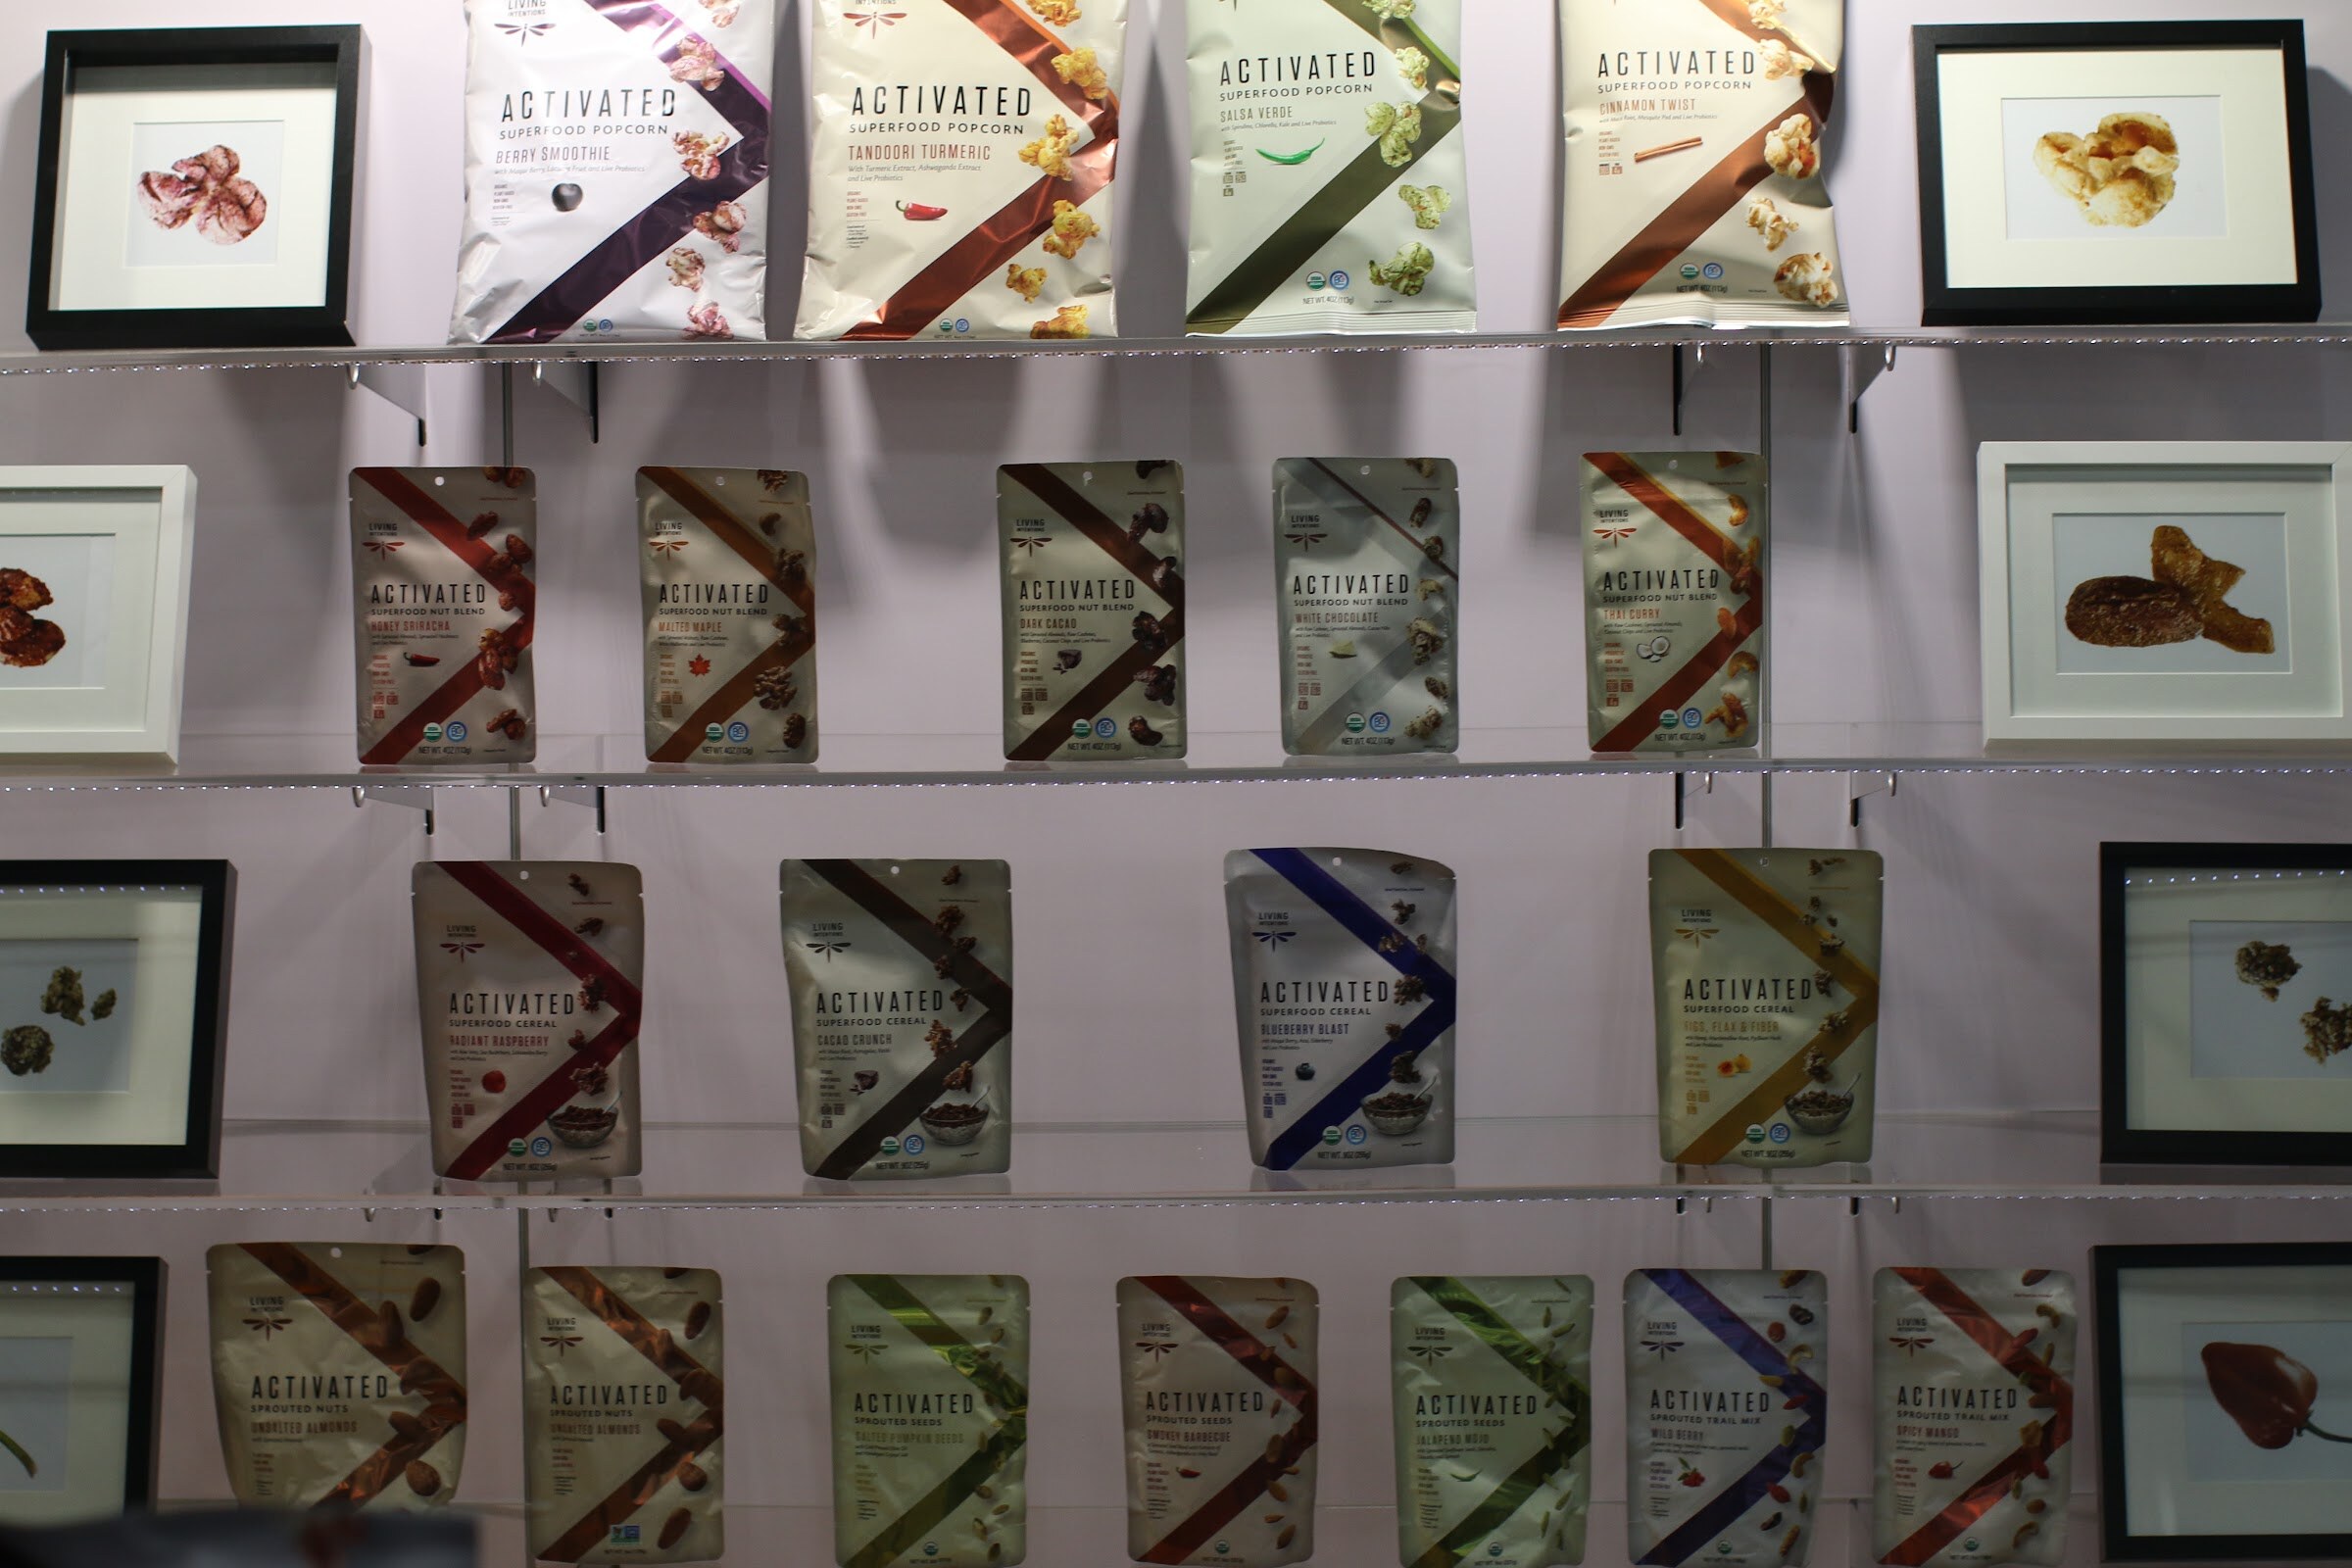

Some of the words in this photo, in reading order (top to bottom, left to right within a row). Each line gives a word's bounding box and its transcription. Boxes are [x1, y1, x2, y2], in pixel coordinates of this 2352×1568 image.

[1220, 51, 1375, 86] ACTIVATED
[1598, 51, 1755, 78] ACTIVATED
[1220, 87, 1299, 102] SUPERFOOD
[1306, 84, 1372, 95] POPCORN
[1597, 81, 1678, 94] SUPERFOOD
[1685, 80, 1751, 89] POPCORN
[502, 89, 675, 122] ACTIVATED
[852, 85, 1030, 116] ACTIVATED
[1599, 99, 1655, 116] CINNAMON
[1660, 98, 1695, 111] TWIST
[1220, 108, 1253, 122] SALSA
[1258, 106, 1293, 119] VERDE
[500, 125, 586, 139] SUPERFOOD
[593, 124, 668, 134] POPCORN
[850, 122, 941, 133] SUPERFOOD
[949, 122, 1024, 134] POPCORN
[496, 148, 536, 164] BERRY
[541, 146, 610, 161] SMOOTHIE
[849, 145, 914, 160] TANDOORI
[922, 144, 991, 160] TURMERIC
[1291, 514, 1320, 523] LIVING
[1599, 509, 1629, 517] LIVING
[368, 522, 398, 531] LIVING
[655, 522, 683, 531] LIVING
[1016, 518, 1046, 527] LIVING
[1294, 574, 1409, 595] ACTIVATED
[1603, 569, 1719, 592] ACTIVATED
[371, 584, 486, 604] ACTIVATED
[659, 584, 768, 604] ACTIVATED
[1019, 579, 1135, 601] ACTIVATED
[1352, 598, 1374, 607] NUT
[1602, 594, 1662, 604] SUPERFOOD
[371, 608, 427, 616] SUPERFOOD
[1019, 604, 1076, 612] SUPERFOOD
[1102, 603, 1134, 612] BLEND
[1296, 612, 1322, 623] WHITE
[1325, 612, 1379, 623] CHOCOLATE
[1604, 609, 1627, 620] THAI
[1630, 609, 1661, 620] CURRY
[371, 620, 400, 632] HONEY
[403, 619, 450, 632] SRIRACHA
[659, 621, 690, 633] MALTED
[693, 621, 722, 633] MAPLE
[1020, 618, 1043, 629] DARK
[1046, 618, 1077, 629] CACAO
[1258, 911, 1289, 921] LIVING
[1682, 908, 1712, 917] LIVING
[812, 922, 843, 932] LIVING
[1260, 981, 1389, 1004] ACTIVATED
[1684, 978, 1811, 1001] ACTIVATED
[449, 993, 575, 1015] ACTIVATED
[815, 990, 944, 1014] ACTIVATED
[1260, 1007, 1325, 1016] SUPERFOOD
[1329, 1007, 1371, 1016] CEREAL
[1684, 1004, 1749, 1014] SUPERFOOD
[1753, 1004, 1794, 1014] CEREAL
[449, 1019, 512, 1028] SUPERFOOD
[515, 1019, 557, 1028] CEREAL
[815, 1017, 883, 1027] SUPERFOOD
[886, 1017, 927, 1026] CEREAL
[1749, 1021, 1780, 1033] FIBER
[1260, 1024, 1315, 1036] BLUEBERRY
[1318, 1023, 1349, 1035] BLAST
[449, 1035, 489, 1048] RADIANT
[492, 1036, 549, 1048] RASPBERRY
[817, 1034, 849, 1047] CACAO
[852, 1033, 893, 1046] CRUNCH
[249, 1296, 284, 1306] LIVING
[851, 1325, 881, 1334] LIVING
[1142, 1323, 1171, 1332] LIVING
[1414, 1327, 1446, 1336] LIVING
[1647, 1321, 1677, 1330] LIVING
[251, 1375, 388, 1399] ACTIVATED
[551, 1384, 668, 1406] ACTIVATED
[1649, 1389, 1770, 1413] ACTIVATED
[1897, 1385, 2017, 1409] ACTIVATED
[855, 1393, 974, 1414] ACTIVATED
[1146, 1391, 1263, 1413] ACTIVATED
[1416, 1395, 1537, 1415] ACTIVATED
[250, 1404, 312, 1413] SPROUTED
[316, 1404, 349, 1413] NUTS
[549, 1409, 602, 1418] SPROUTED
[605, 1409, 633, 1418] NUTS
[1146, 1414, 1198, 1425] SPROUTED
[1649, 1413, 1703, 1424] SPROUTED
[1706, 1416, 1738, 1425] TRAIL
[1896, 1410, 1950, 1421] SPROUTED
[306, 1420, 357, 1435] ALMONDS
[855, 1417, 907, 1426] SPROUTED
[910, 1418, 943, 1427] SEEDS
[1415, 1419, 1470, 1428] SPROUTED
[1147, 1429, 1181, 1442] SMOKEY
[1183, 1430, 1231, 1443] BARBECUE
[1650, 1428, 1673, 1441] WILD
[1676, 1429, 1704, 1442] BERRY
[1896, 1425, 1924, 1438] SPICY
[1926, 1426, 1960, 1439] MANGO
[1464, 1434, 1490, 1445] MOJO
